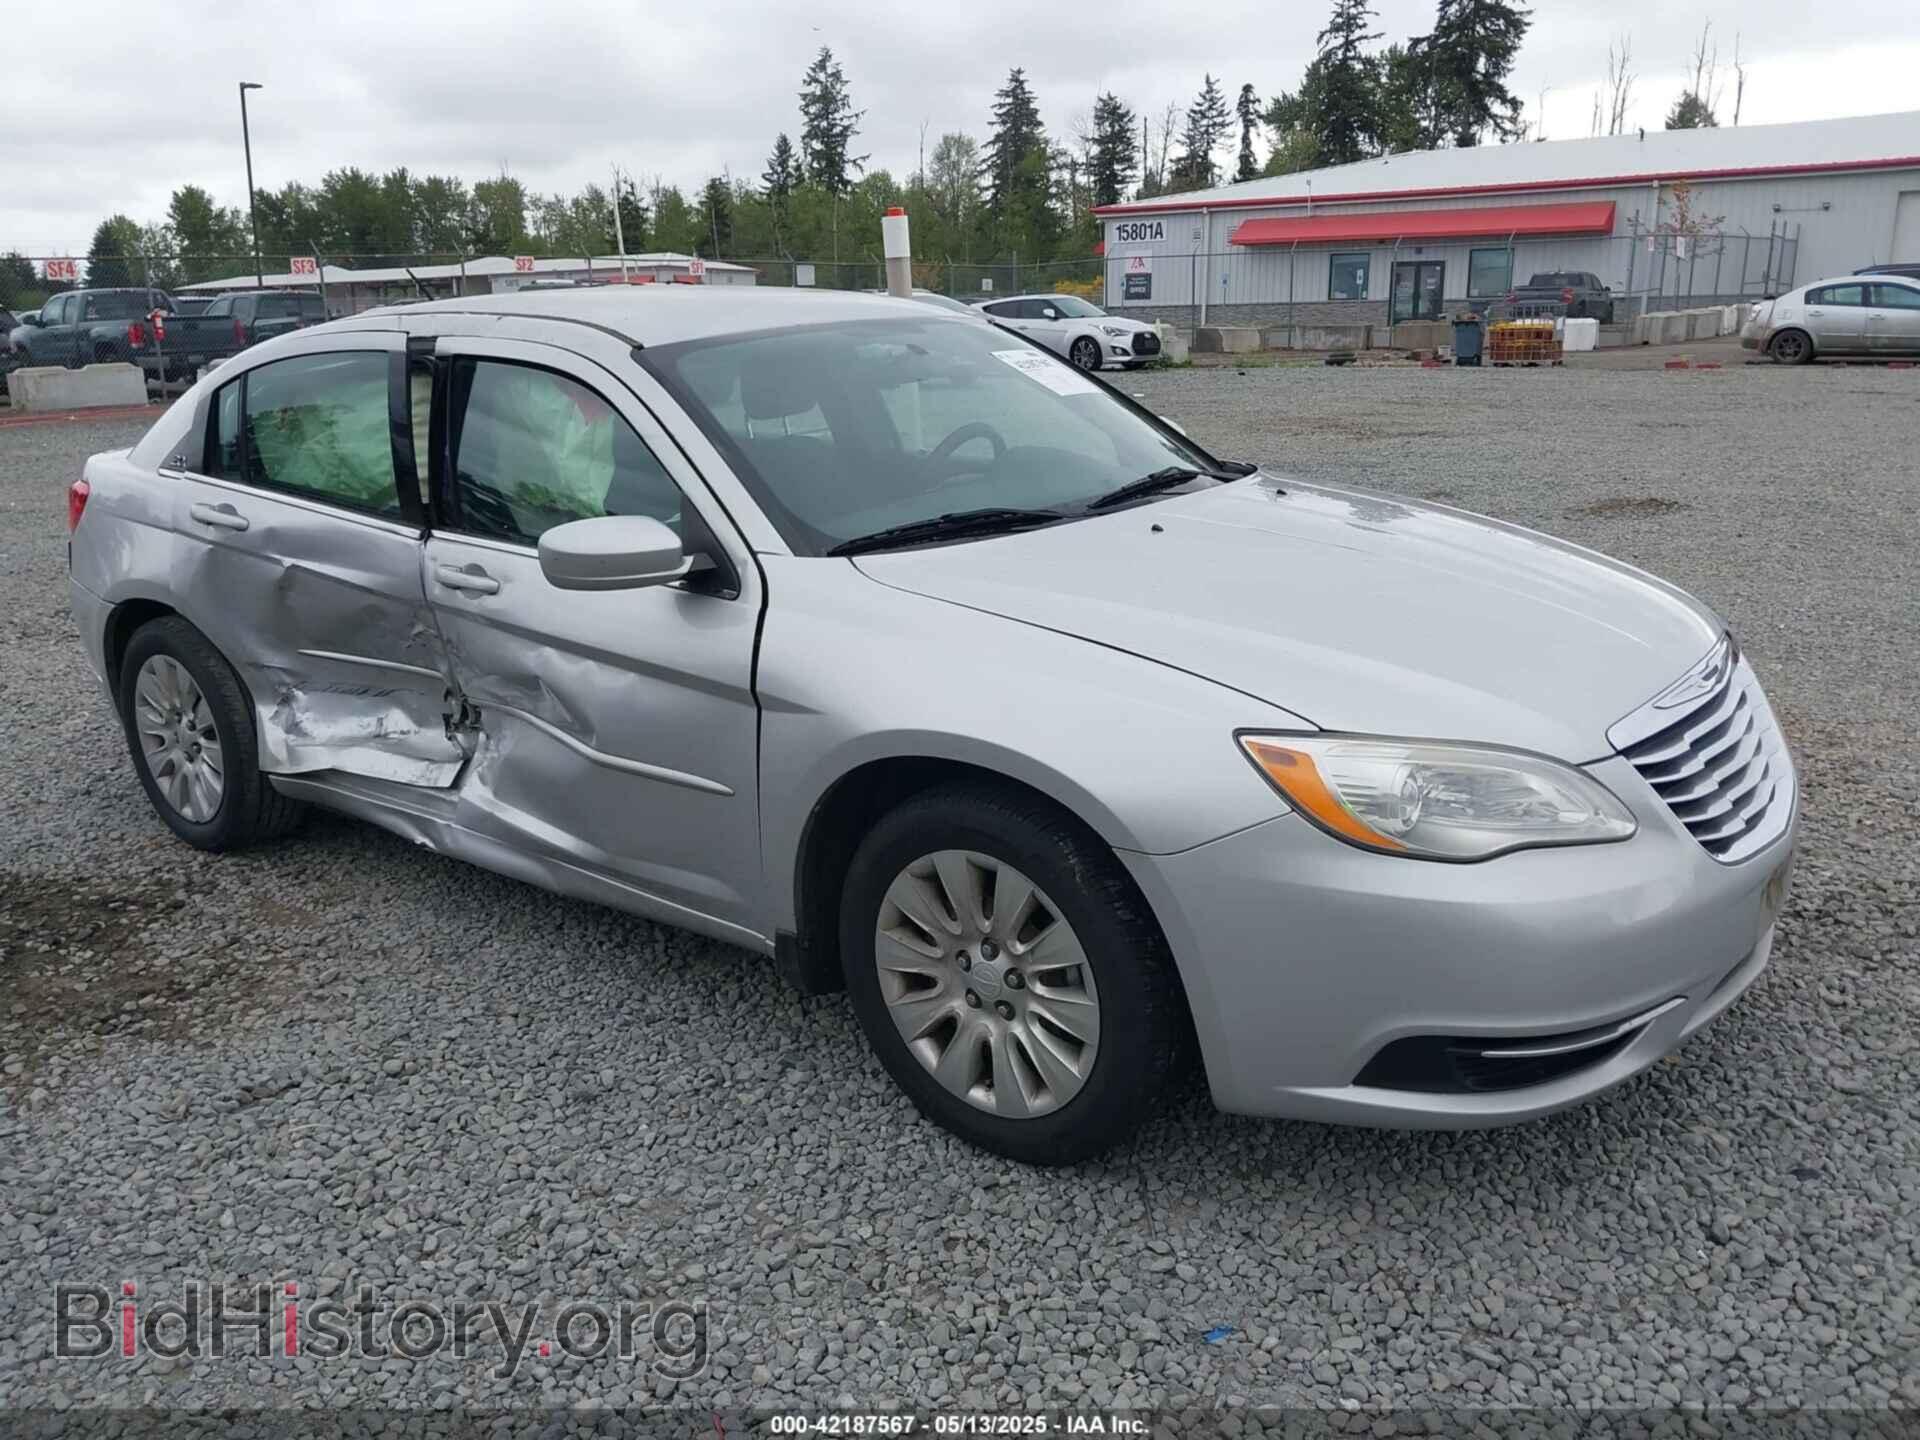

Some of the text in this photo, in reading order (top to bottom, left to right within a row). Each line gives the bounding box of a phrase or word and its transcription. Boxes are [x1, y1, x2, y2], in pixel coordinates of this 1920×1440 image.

[1116, 222, 1164, 241] 15801A
[48, 261, 75, 277] SF4
[293, 259, 314, 274] SF3
[516, 258, 533, 271] SF2
